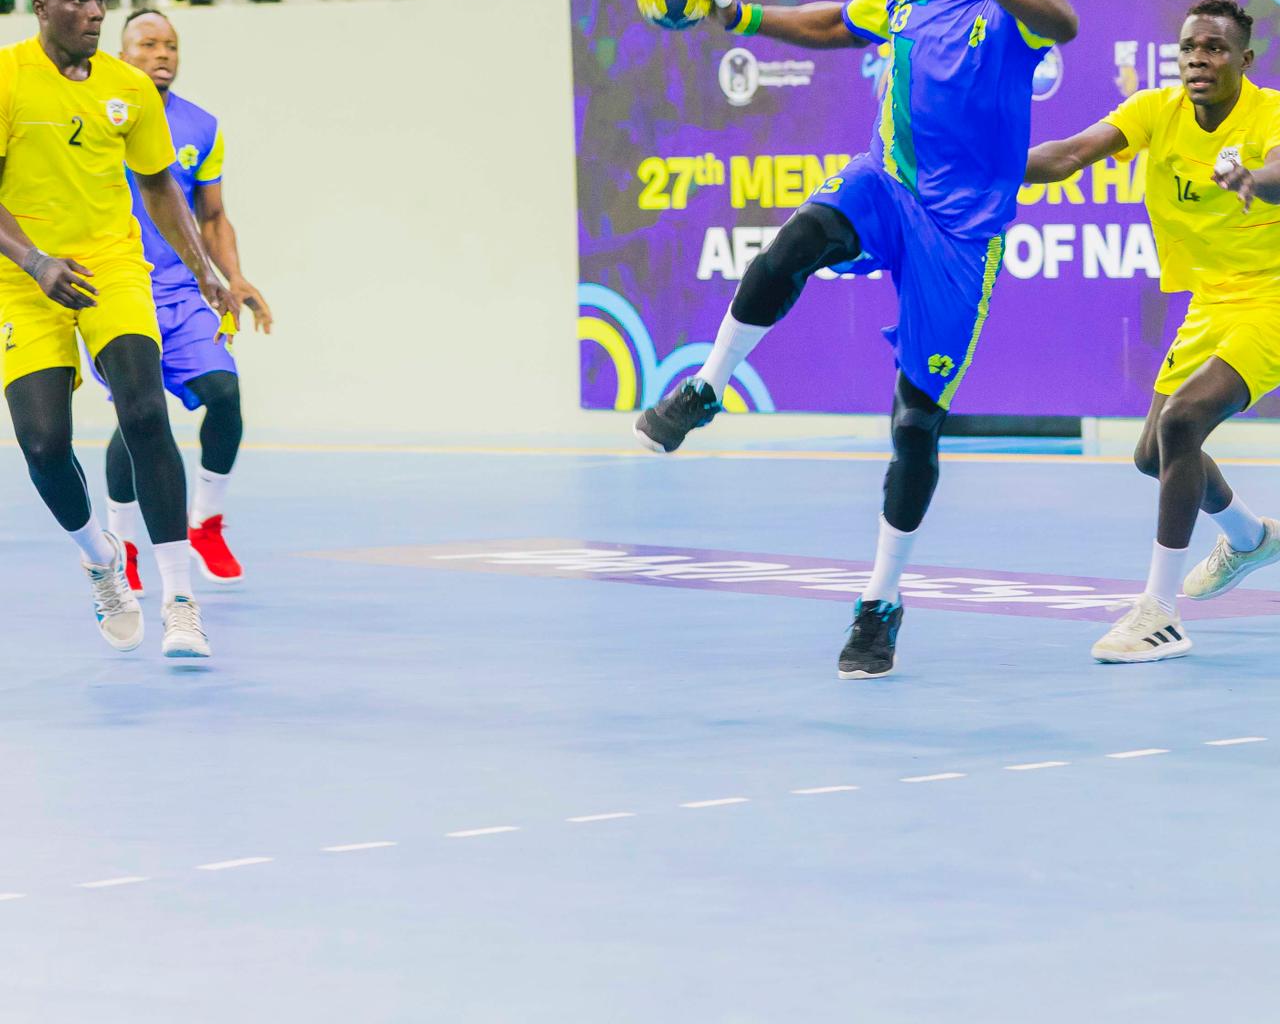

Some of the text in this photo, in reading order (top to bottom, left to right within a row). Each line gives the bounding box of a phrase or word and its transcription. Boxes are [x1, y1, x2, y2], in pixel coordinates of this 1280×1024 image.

[68, 115, 82, 146] 2
[637, 152, 725, 210] 27th
[1174, 175, 1200, 202] 14
[1003, 223, 1076, 280] OF
